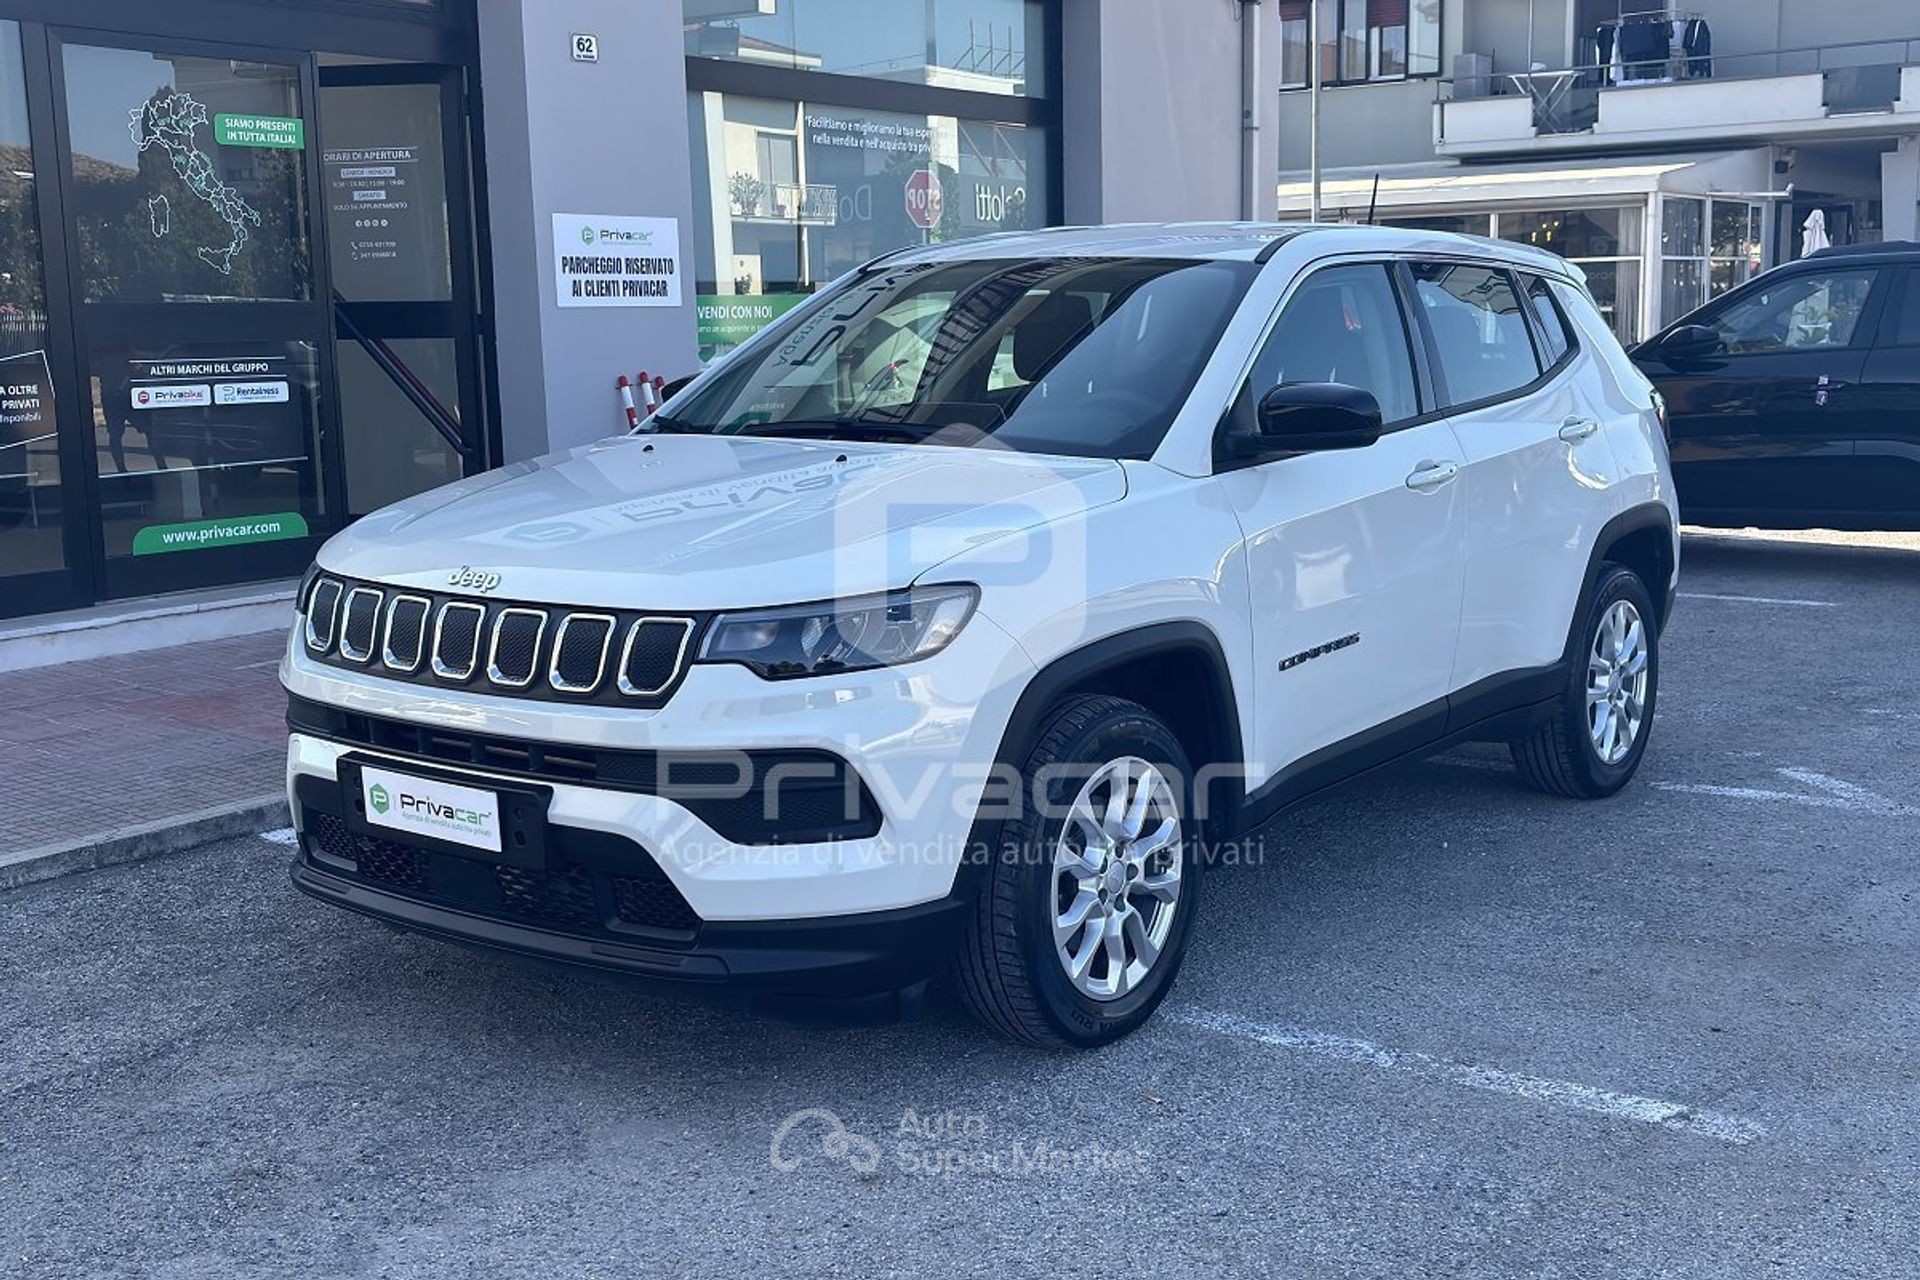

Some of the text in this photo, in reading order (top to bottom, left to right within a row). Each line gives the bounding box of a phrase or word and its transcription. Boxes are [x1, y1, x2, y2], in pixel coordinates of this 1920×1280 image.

[576, 37, 593, 52] 62
[225, 118, 296, 132] SIAMO PRESENTI
[227, 131, 296, 144] IN TUTTA ITALIA!
[364, 150, 411, 160] APERTURA
[600, 228, 653, 241] Privacar
[562, 256, 675, 275] PARCHEGGIO RISERVATO
[572, 279, 668, 297] AI CLIENTI PRIVACAR
[698, 305, 773, 319] VENDI CON NOI
[150, 362, 268, 376] ALTRI MARCHI DEL GRUPPO
[8, 384, 38, 395] OLTRE
[237, 386, 279, 397] Rentalness
[2, 398, 40, 409] PRIVATI
[162, 522, 281, 544] www.privacar.com
[448, 565, 502, 593] Jeep
[400, 793, 491, 826] Privacar
